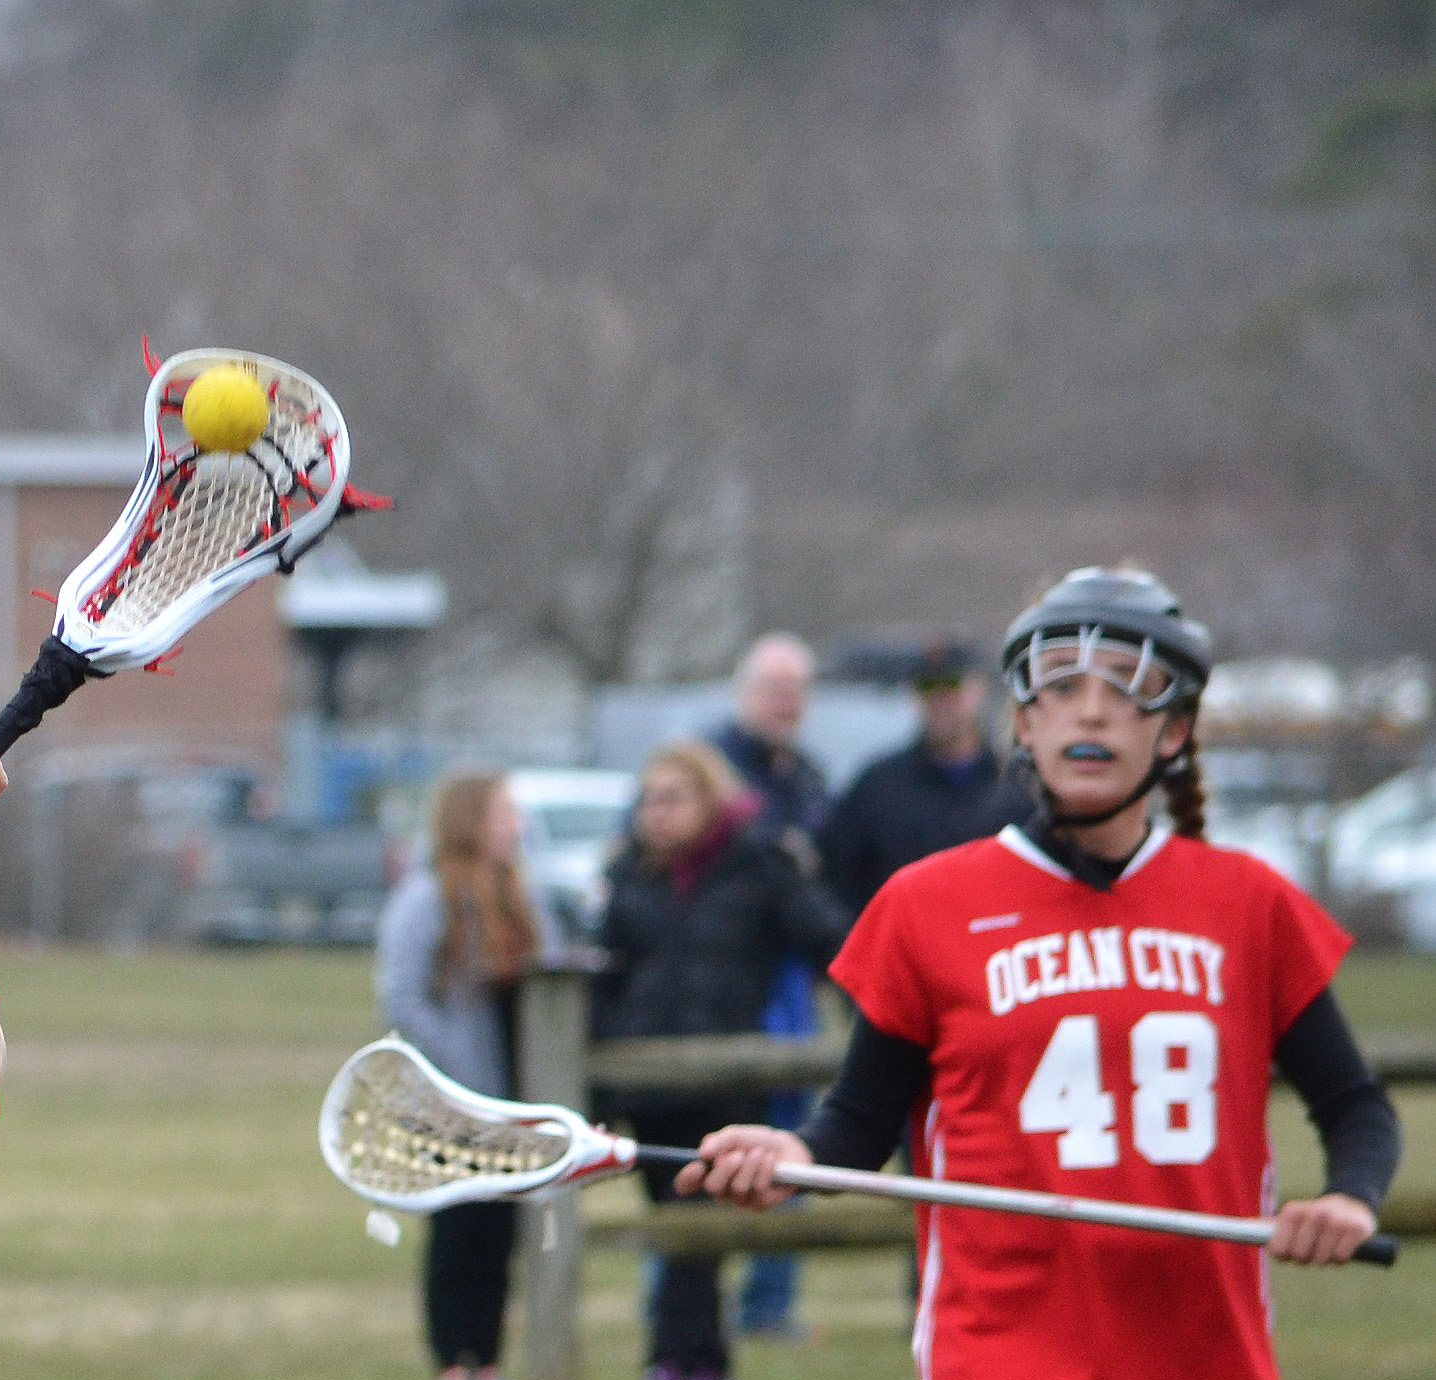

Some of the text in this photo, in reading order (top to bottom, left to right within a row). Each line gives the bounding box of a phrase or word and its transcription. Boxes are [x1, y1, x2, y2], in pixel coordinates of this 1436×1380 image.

[987, 926, 1225, 1016] OCEAN CITY
[1019, 1012, 1220, 1169] 48
